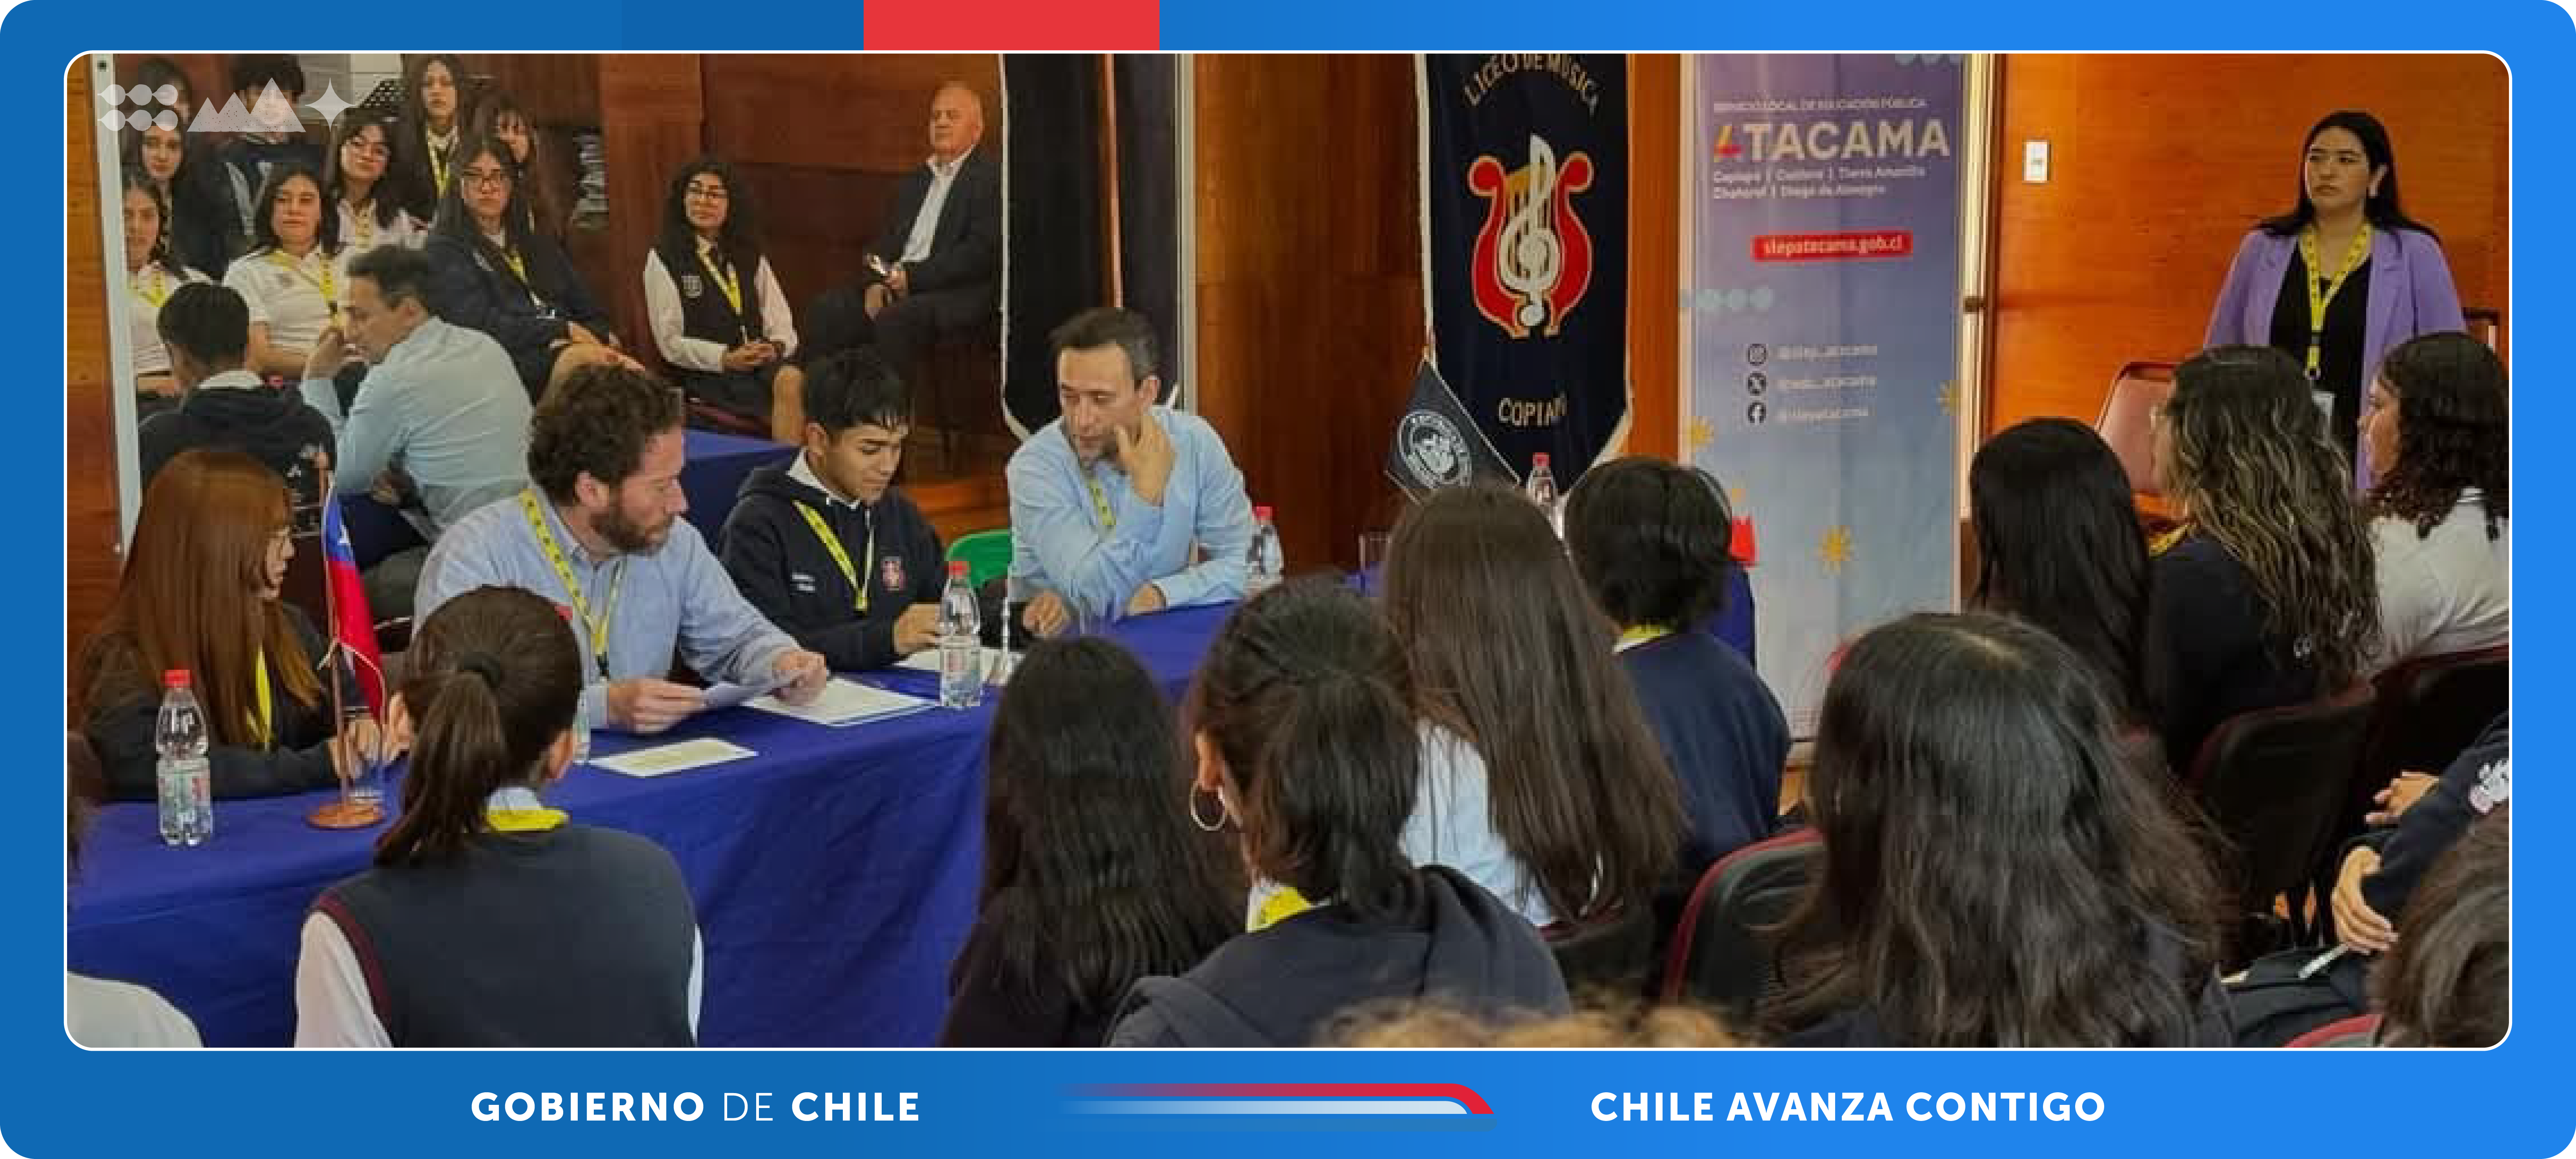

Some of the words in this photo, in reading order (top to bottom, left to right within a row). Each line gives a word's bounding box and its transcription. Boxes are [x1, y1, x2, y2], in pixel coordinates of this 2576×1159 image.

[1463, 54, 1519, 107] LICEO
[1712, 118, 1951, 162] ATACAMA
[1497, 390, 1568, 428] COPIAP
